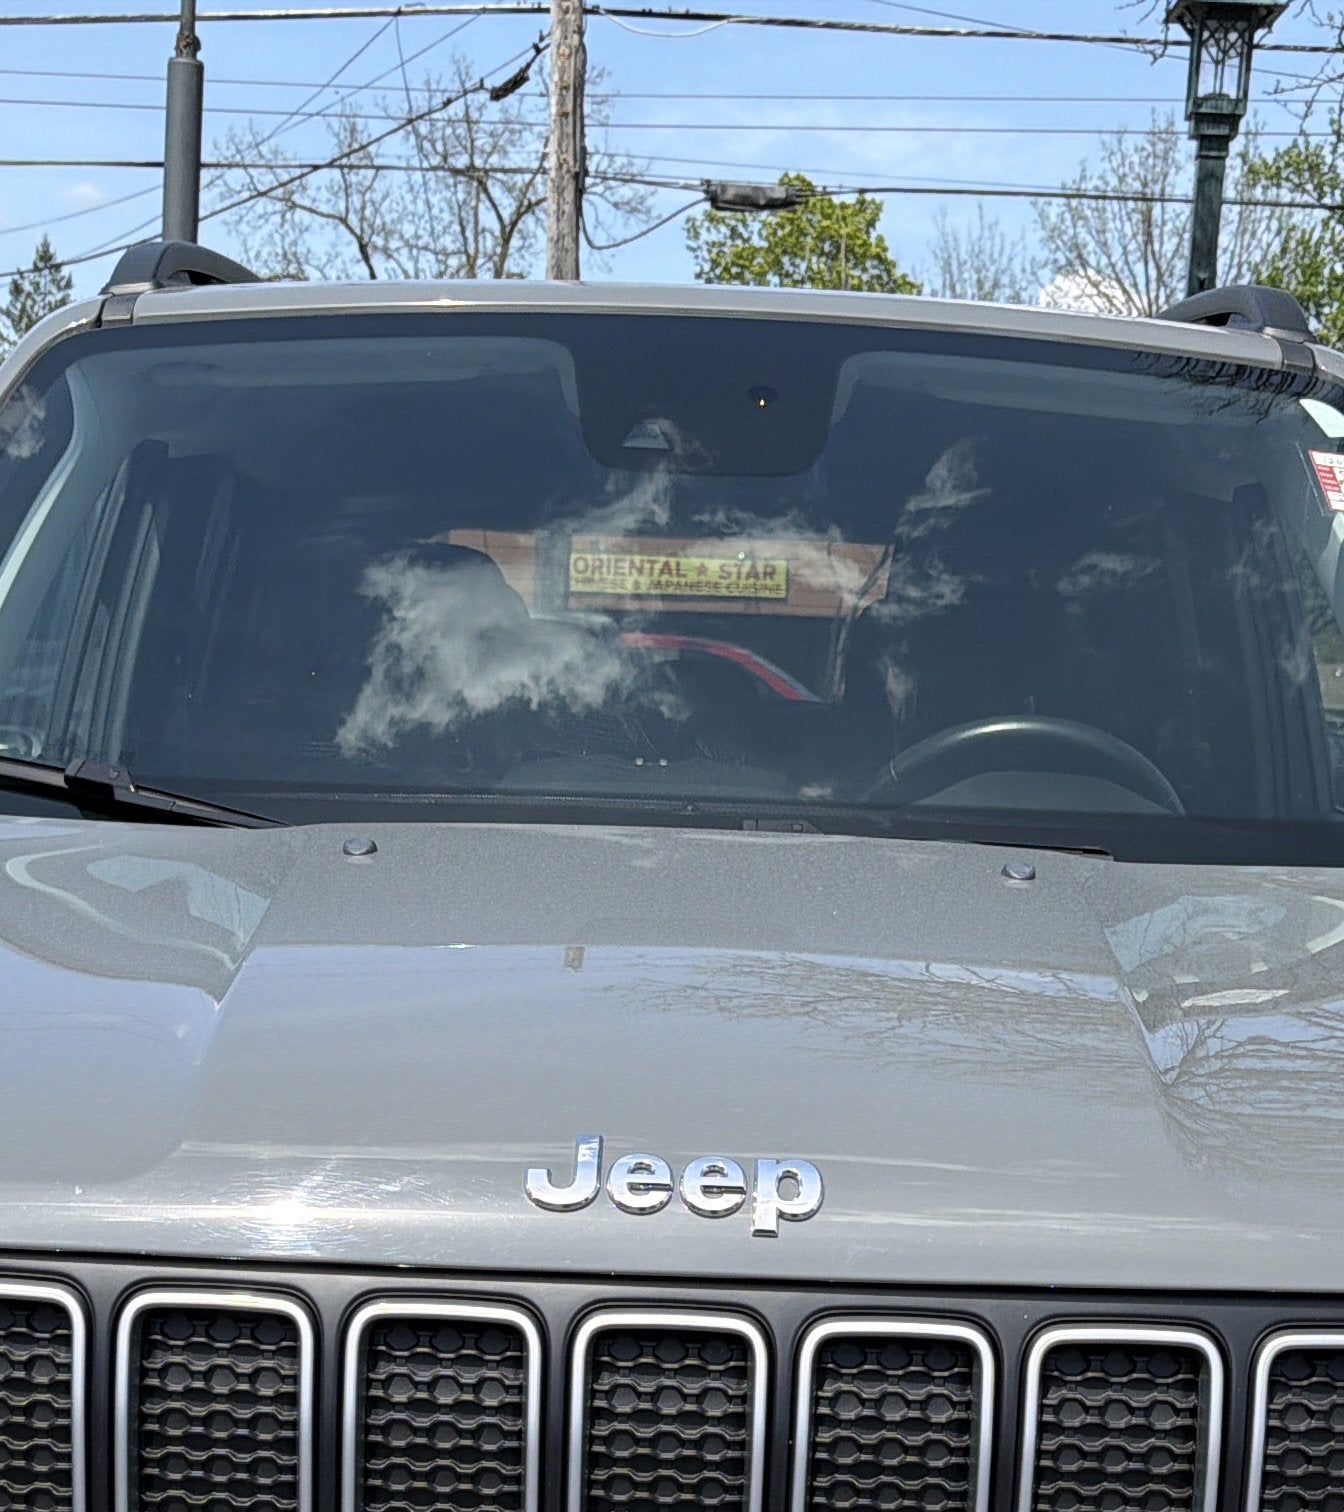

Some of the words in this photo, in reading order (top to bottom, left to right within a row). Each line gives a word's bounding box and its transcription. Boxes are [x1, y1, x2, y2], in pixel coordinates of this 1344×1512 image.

[573, 556, 686, 579] ORIENTAL
[719, 562, 777, 581] STAR
[523, 1134, 824, 1238] Jeep
